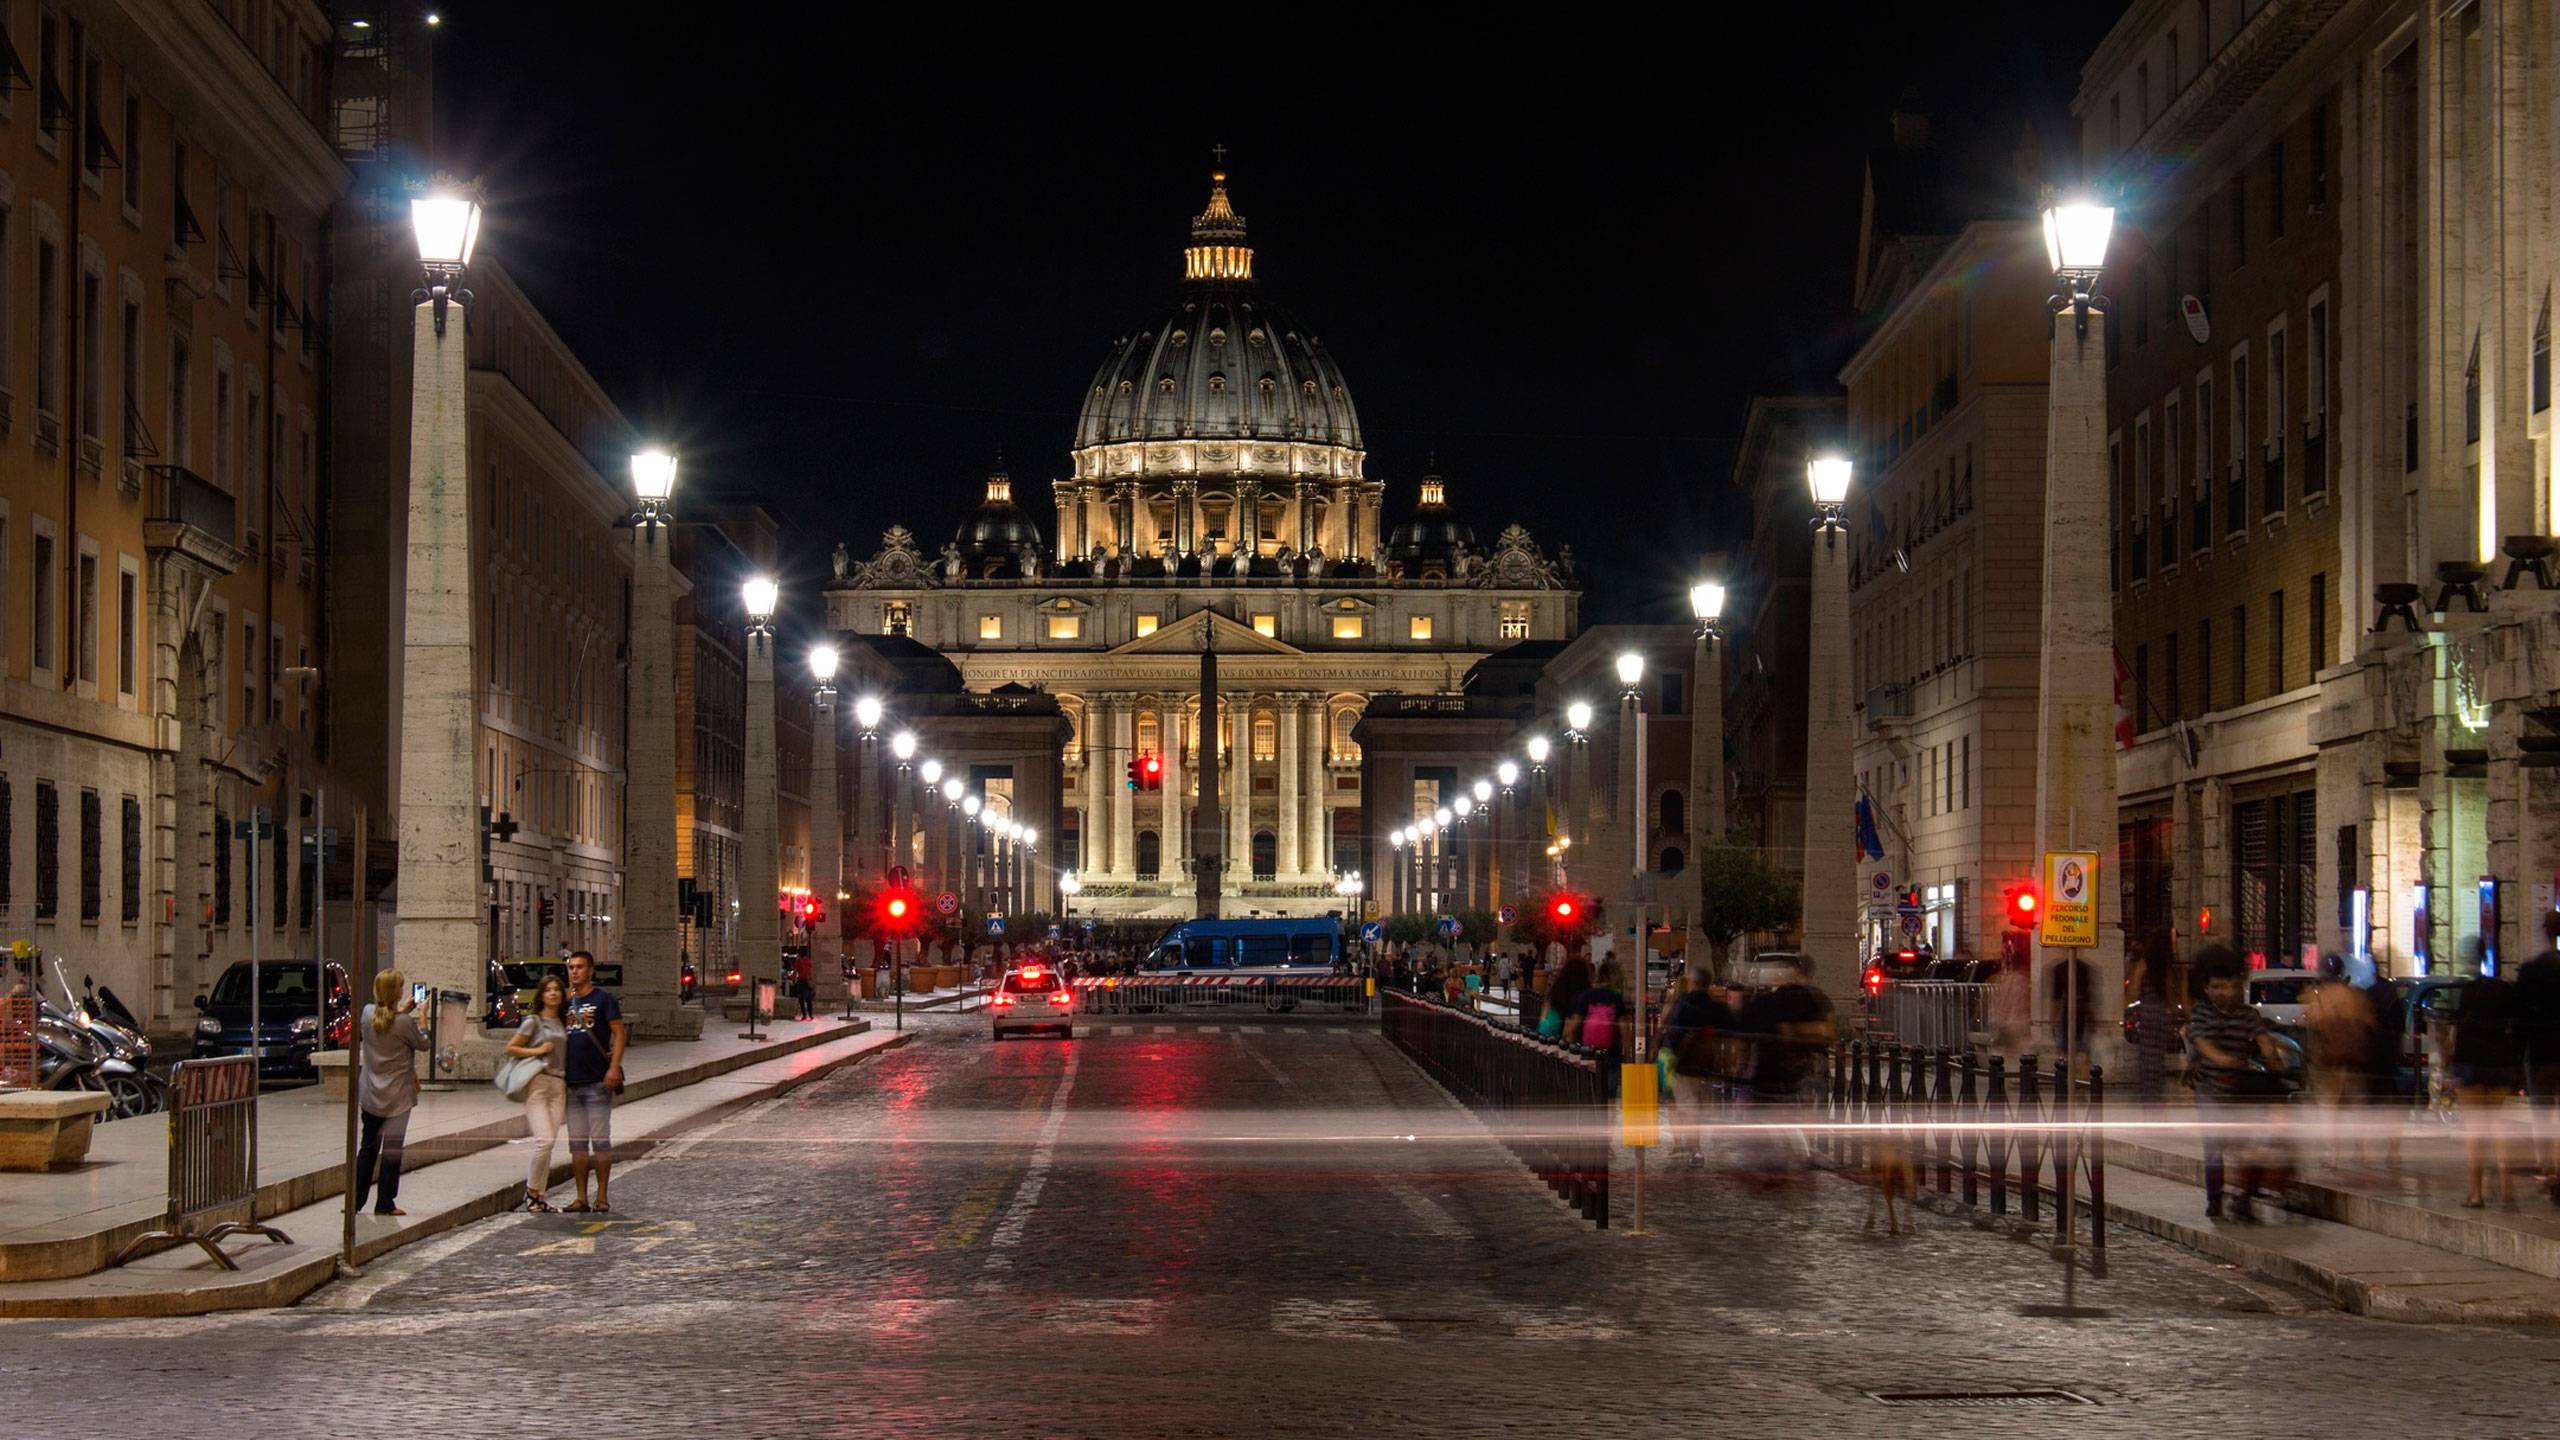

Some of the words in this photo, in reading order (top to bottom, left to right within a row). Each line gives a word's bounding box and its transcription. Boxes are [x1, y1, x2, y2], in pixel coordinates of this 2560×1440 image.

[2050, 904, 2088, 912] PERCORSO
[2050, 914, 2088, 923] PEDONALE
[2062, 925, 2076, 933] DEL
[2045, 934, 2091, 943] PELLEGRINO
